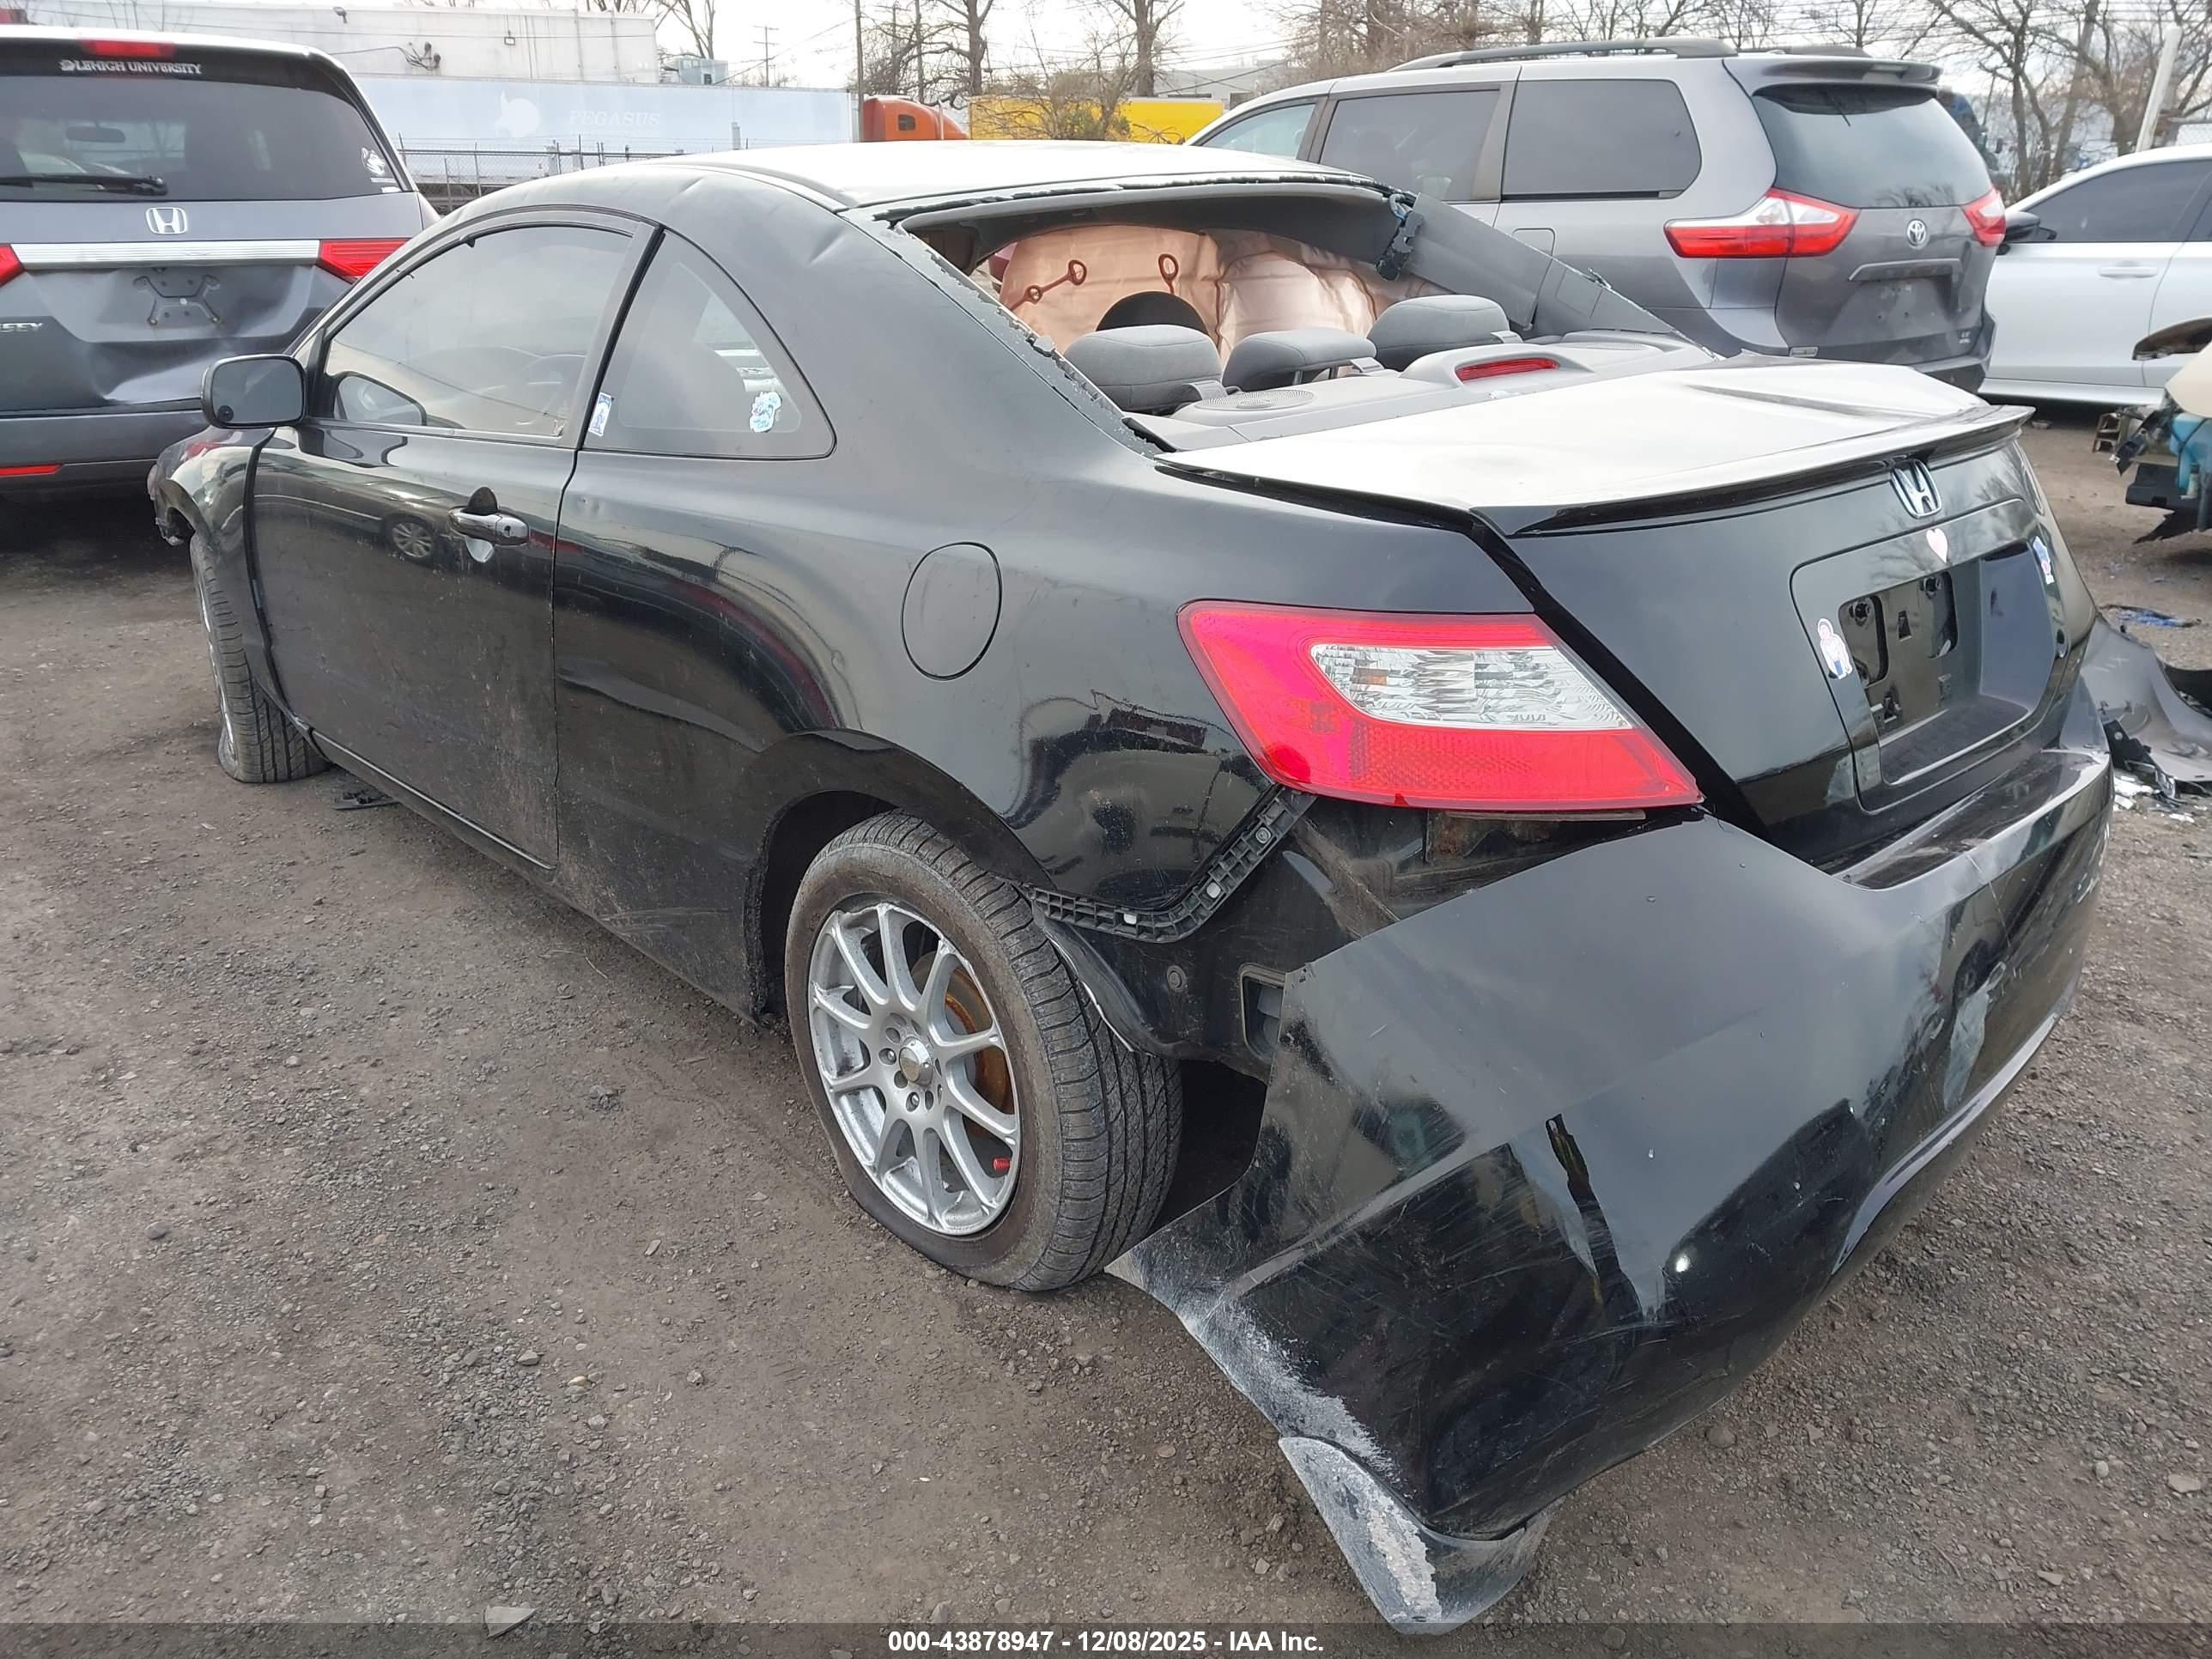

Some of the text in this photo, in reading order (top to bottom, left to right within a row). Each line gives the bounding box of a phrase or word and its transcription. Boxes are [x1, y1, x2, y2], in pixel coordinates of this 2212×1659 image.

[76, 59, 202, 75] LEHIGH UNIVERSITY
[568, 109, 661, 127] PEGASUS
[0, 322, 43, 332] SEY
